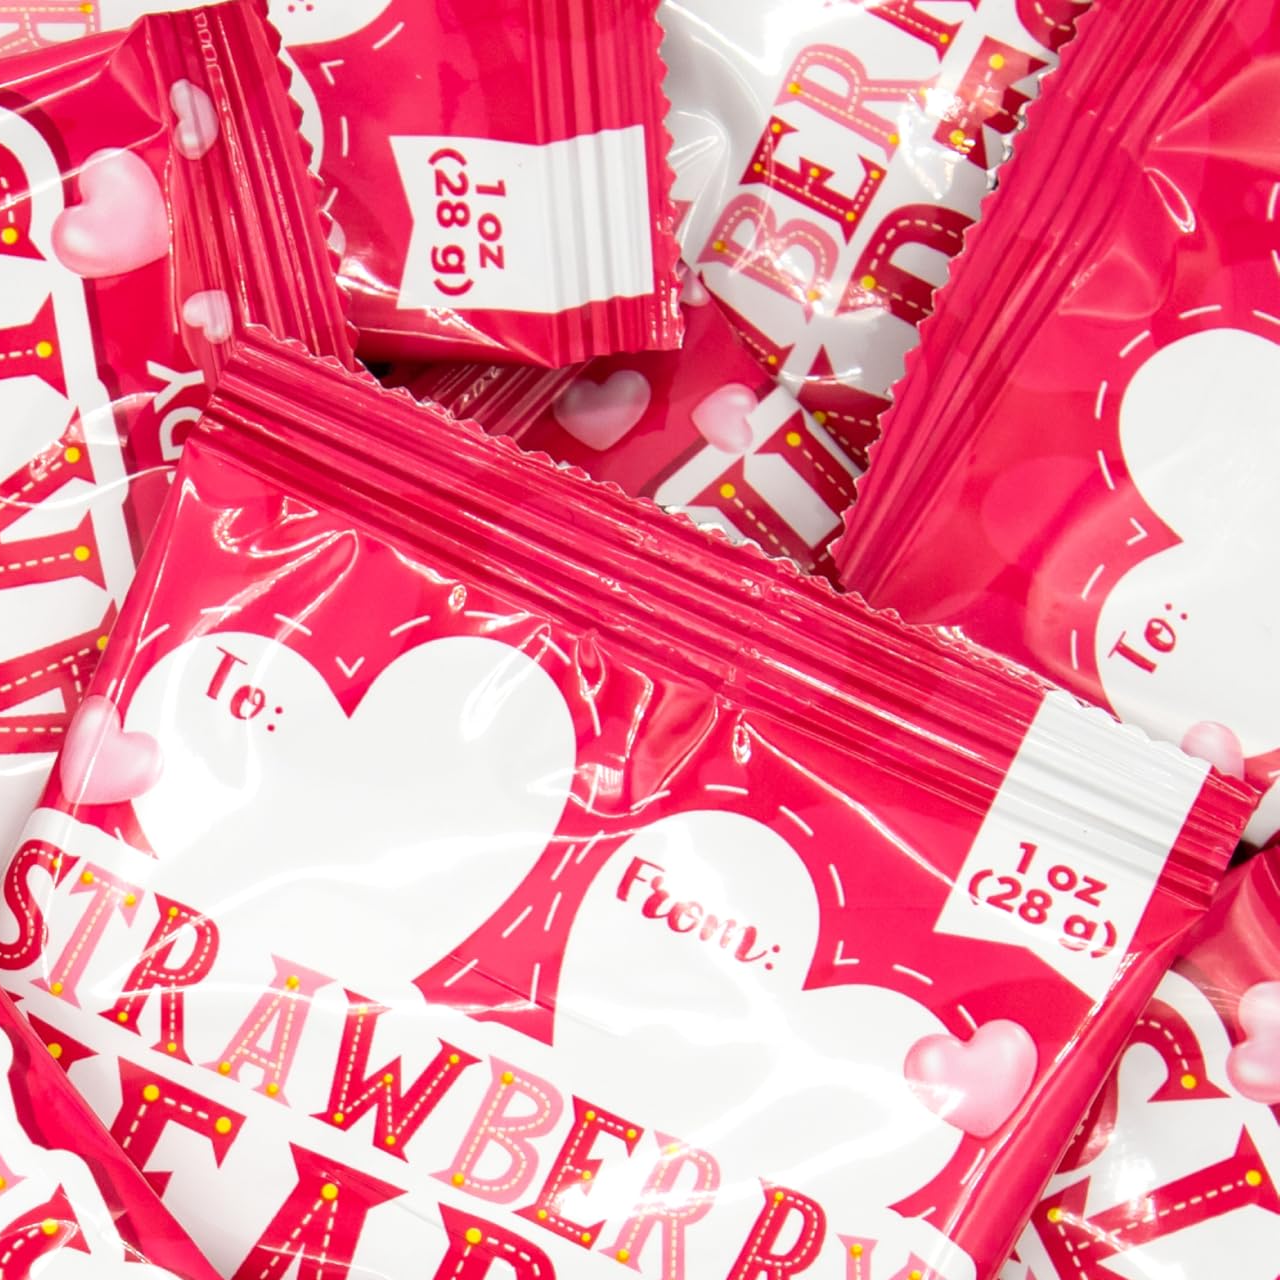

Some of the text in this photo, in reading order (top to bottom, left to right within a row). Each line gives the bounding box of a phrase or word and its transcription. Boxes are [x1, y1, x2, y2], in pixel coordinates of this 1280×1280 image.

[428, 148, 474, 295] (28 g)
[475, 179, 506, 271] 1 oz
[1107, 602, 1189, 675] To:
[206, 645, 284, 733] To:
[616, 856, 782, 971] From:
[967, 869, 1048, 929] (28
[1014, 842, 1108, 907] 1 oz
